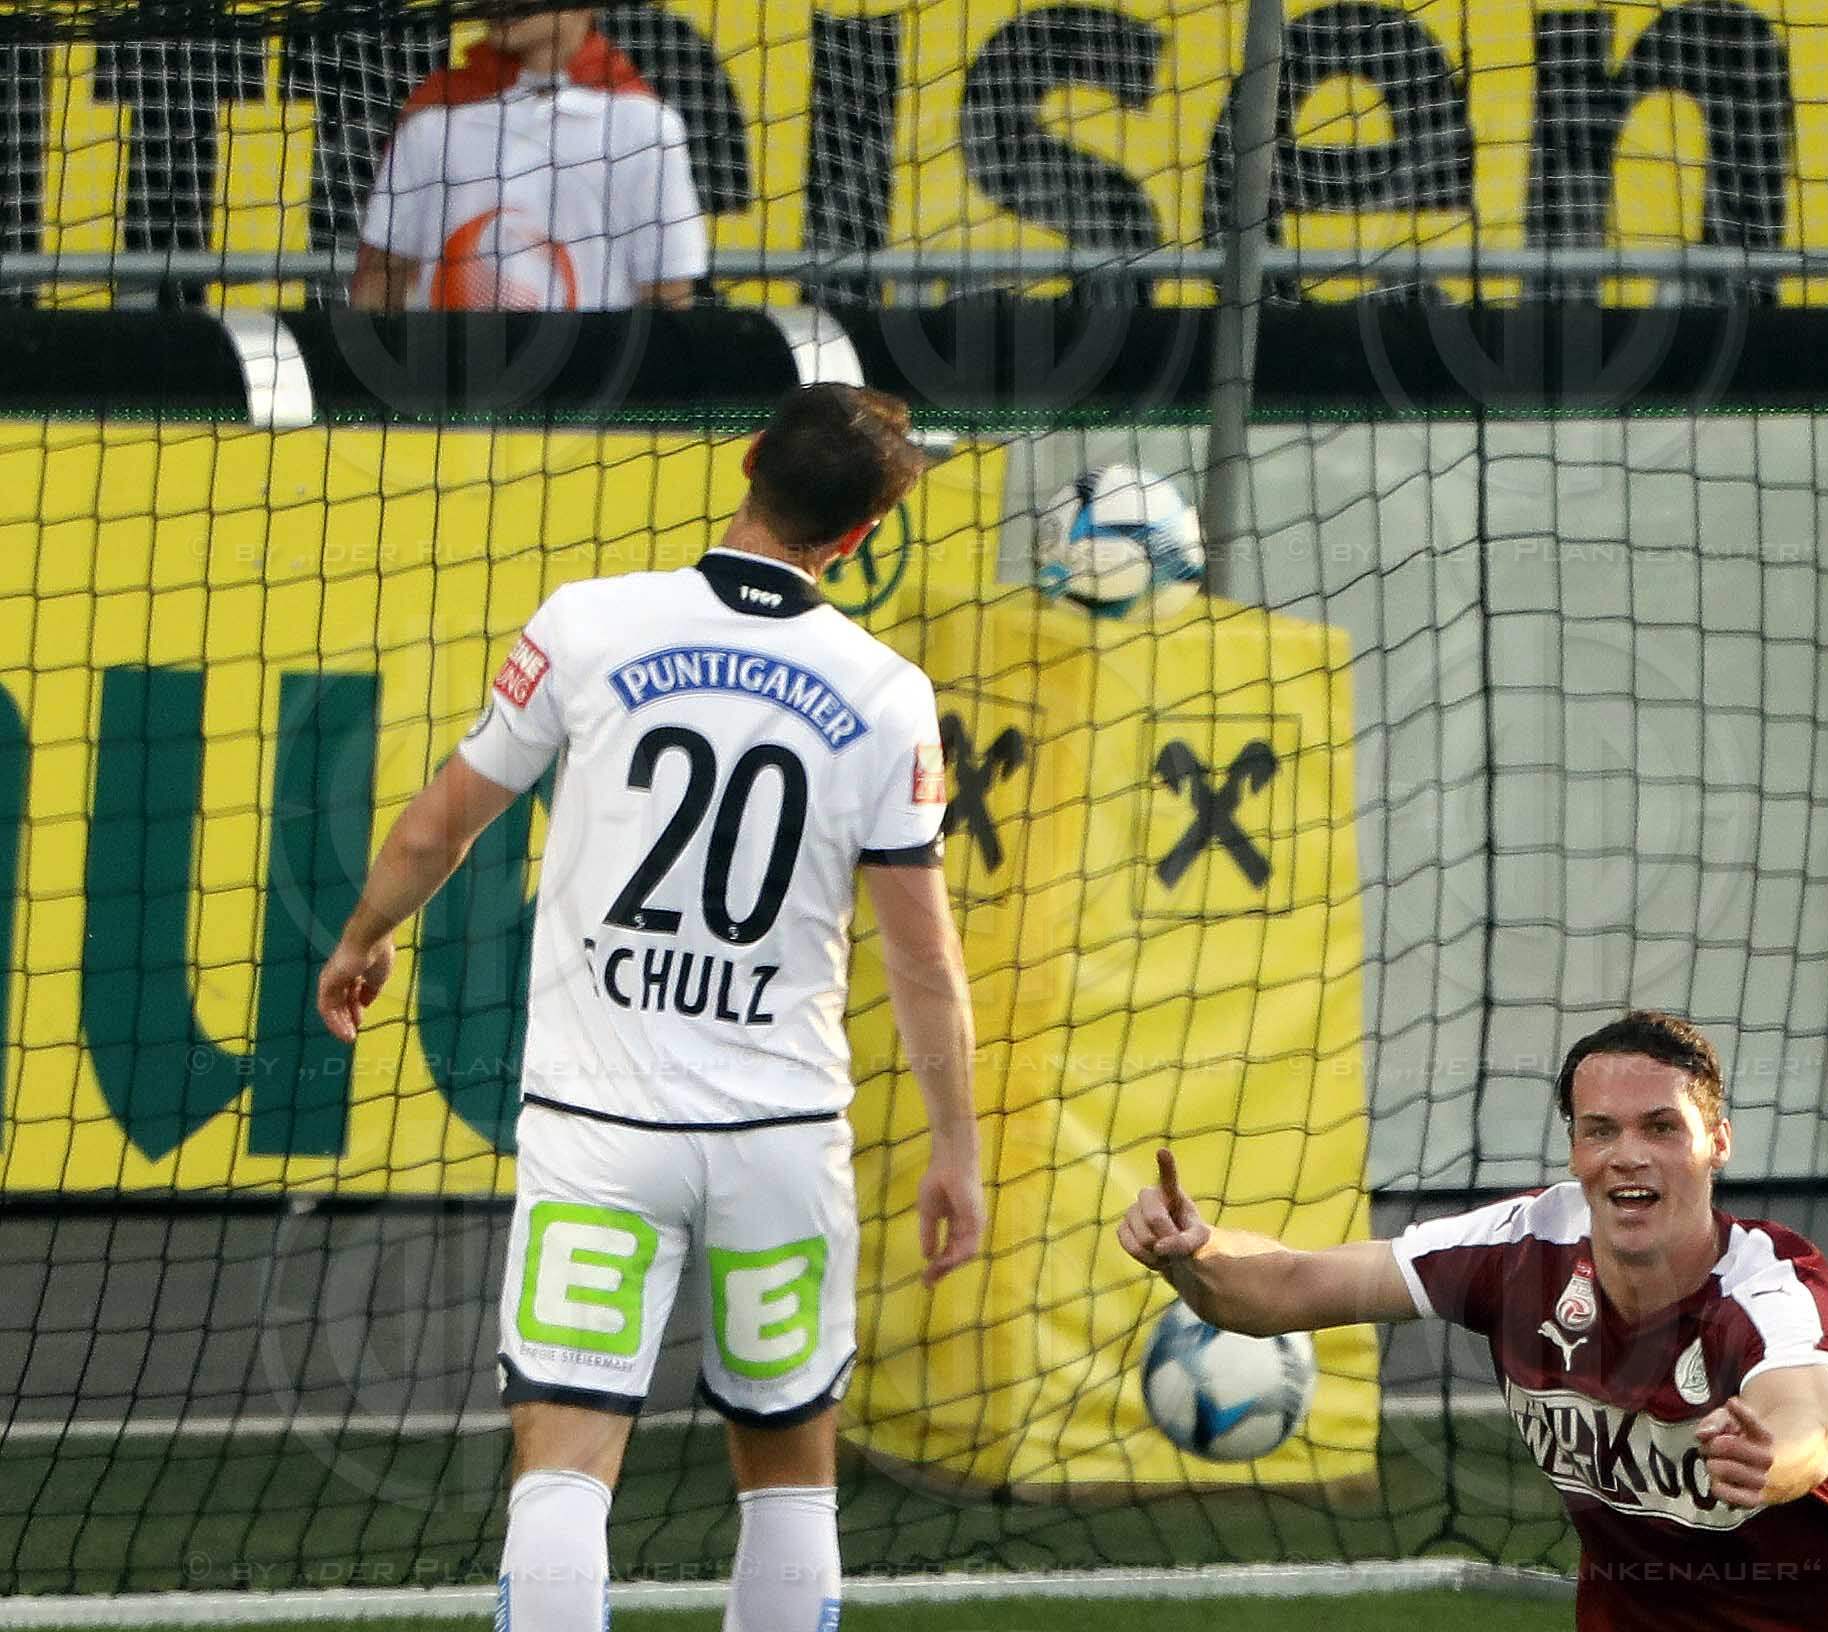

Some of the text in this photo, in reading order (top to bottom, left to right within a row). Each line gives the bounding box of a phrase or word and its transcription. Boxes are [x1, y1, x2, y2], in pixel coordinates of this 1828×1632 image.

[619, 649, 858, 741] PUNTIGAMER
[601, 725, 809, 946] 20
[1593, 1406, 1717, 1511] Koc
